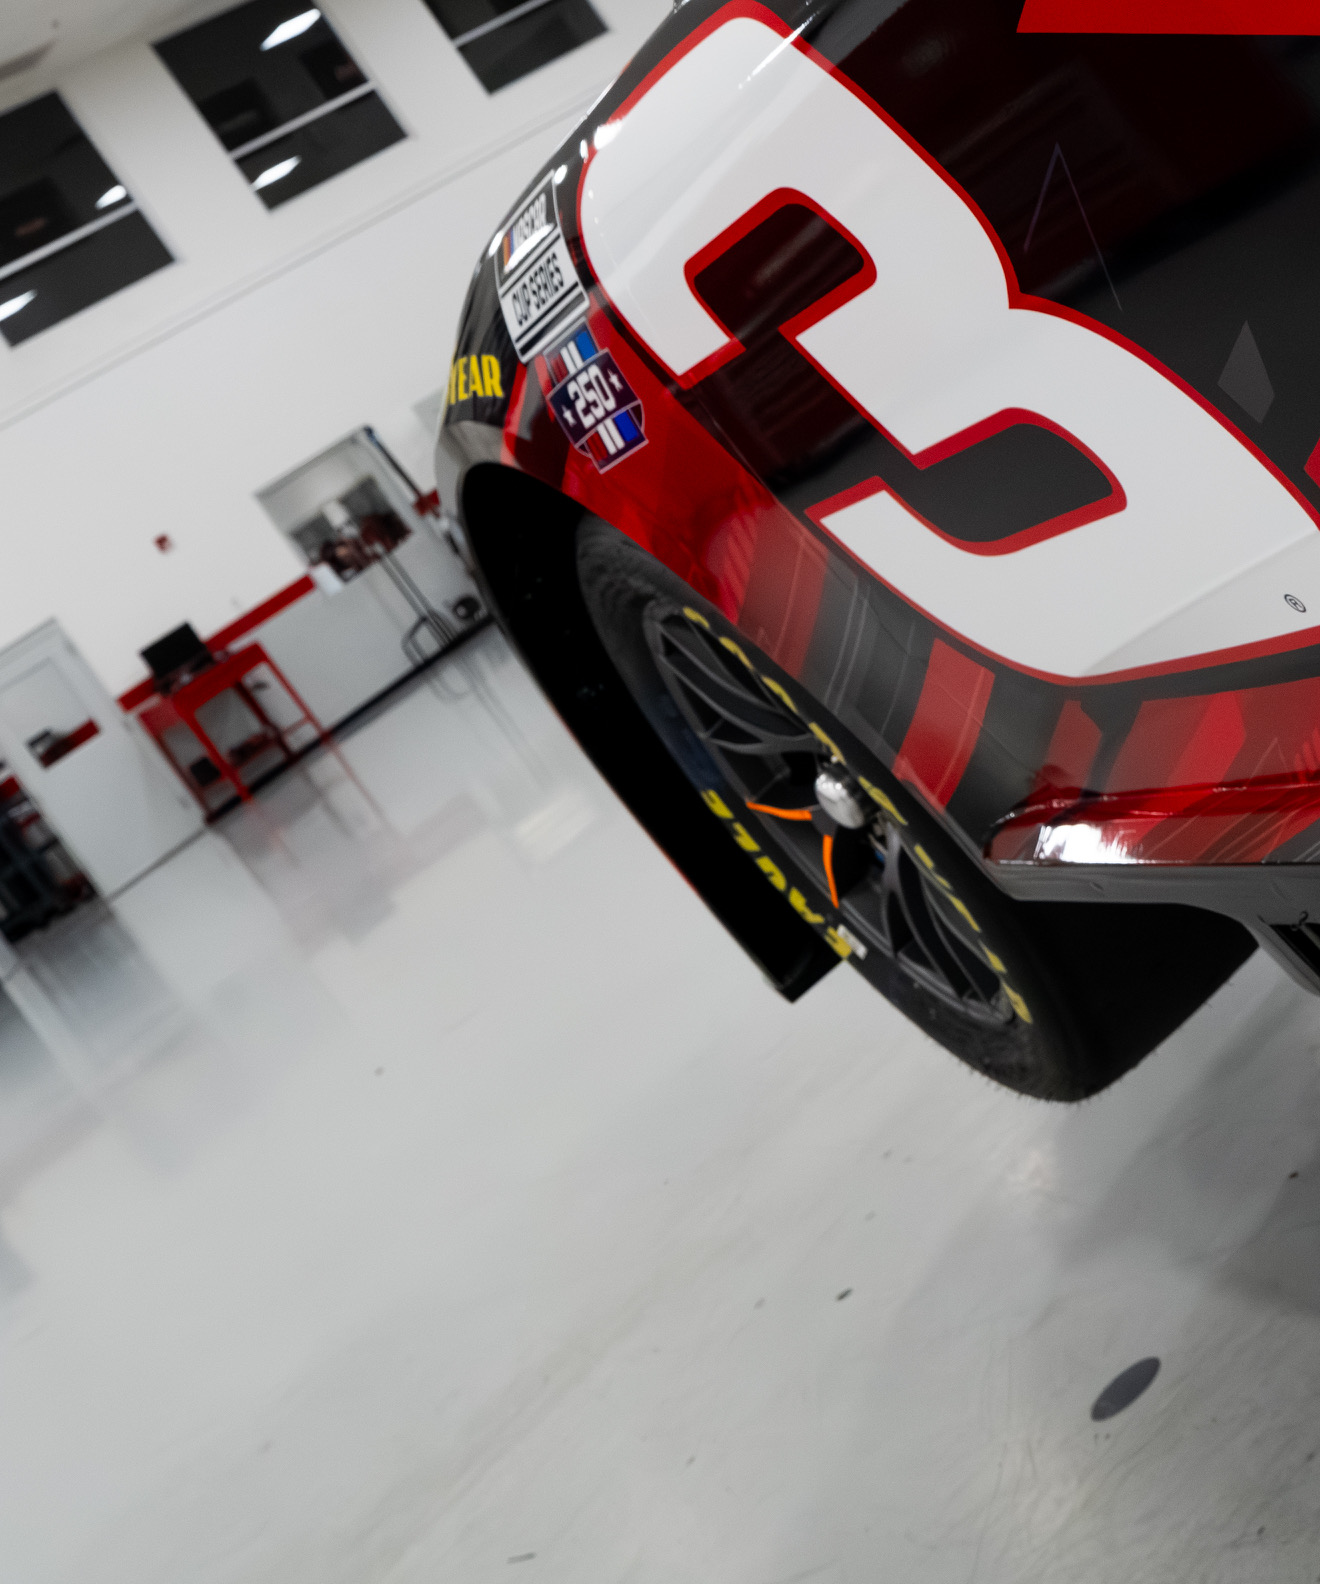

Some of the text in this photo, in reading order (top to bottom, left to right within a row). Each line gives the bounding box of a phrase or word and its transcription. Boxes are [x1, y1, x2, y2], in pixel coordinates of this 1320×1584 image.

[511, 252, 564, 326] CUP SERIES
[567, 364, 617, 429] 250
